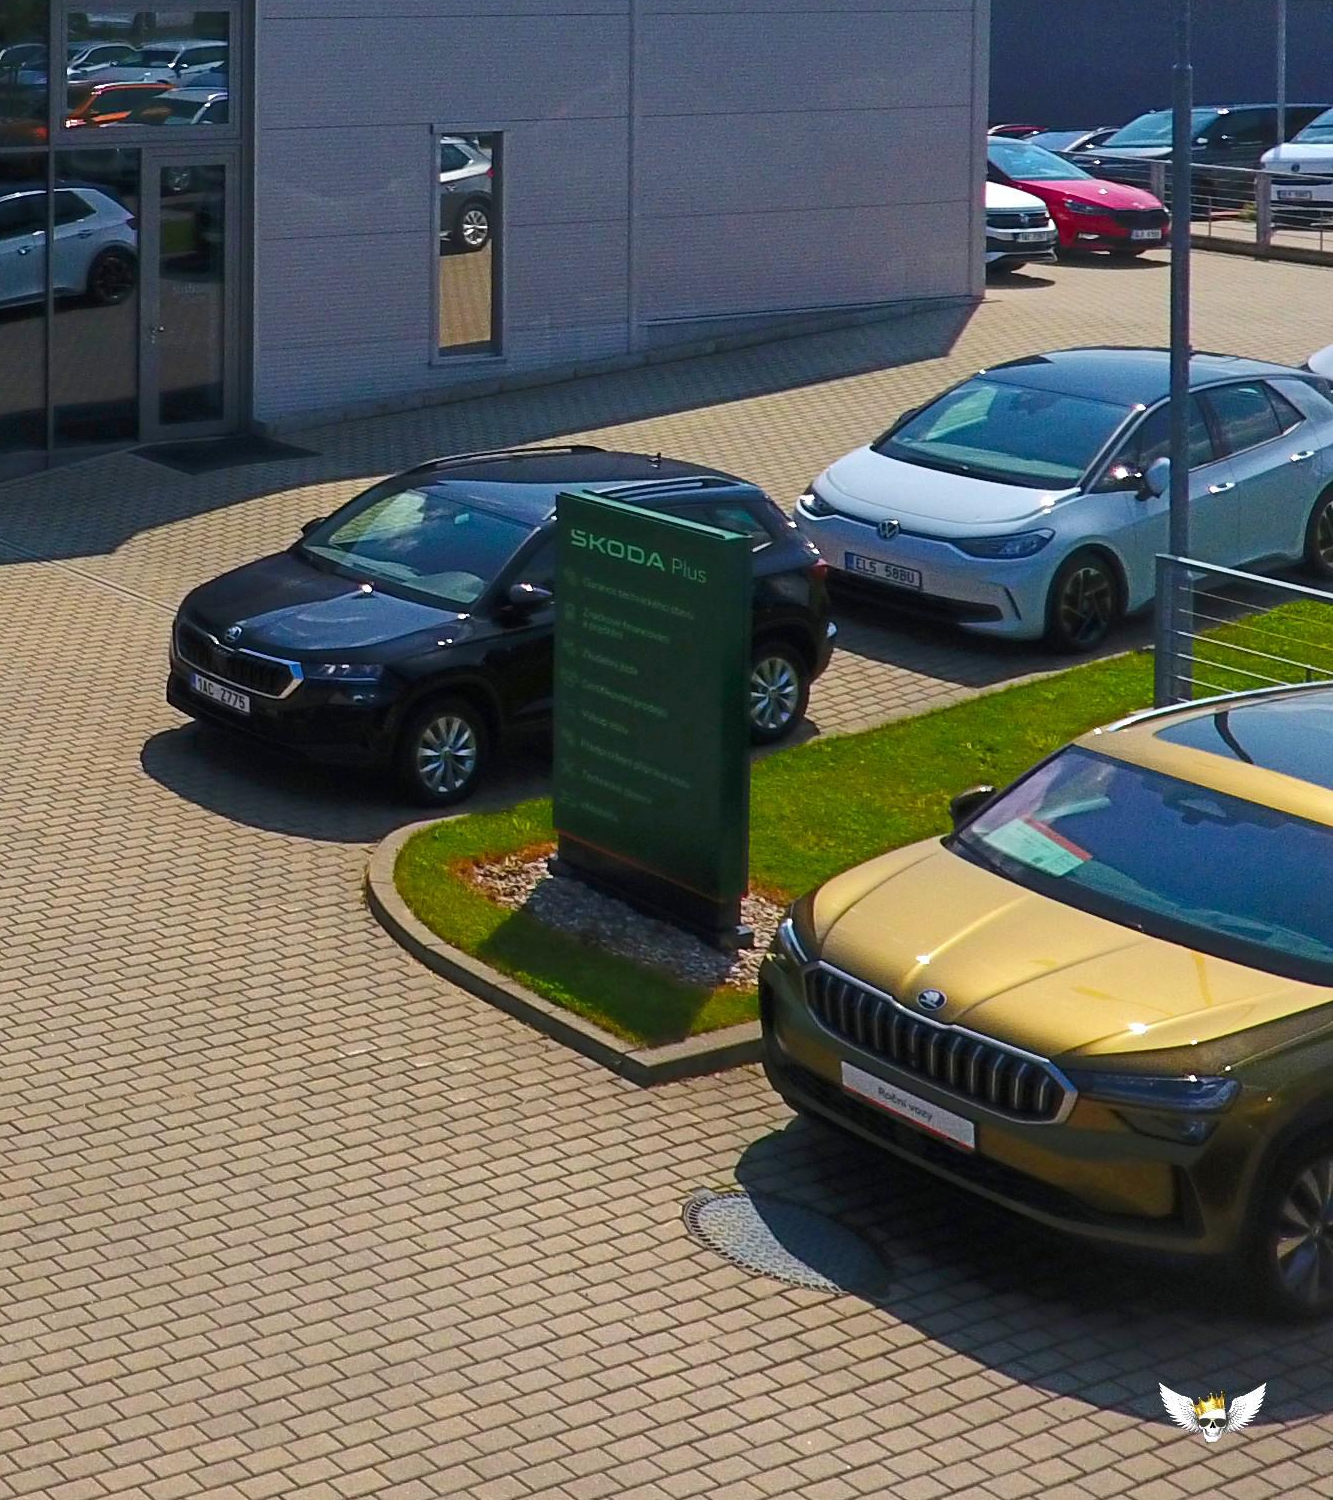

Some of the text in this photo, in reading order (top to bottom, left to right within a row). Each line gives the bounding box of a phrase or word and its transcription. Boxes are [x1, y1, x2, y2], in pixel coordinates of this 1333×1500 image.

[671, 557, 707, 583] Plus
[197, 678, 246, 709] 1AC 2775
